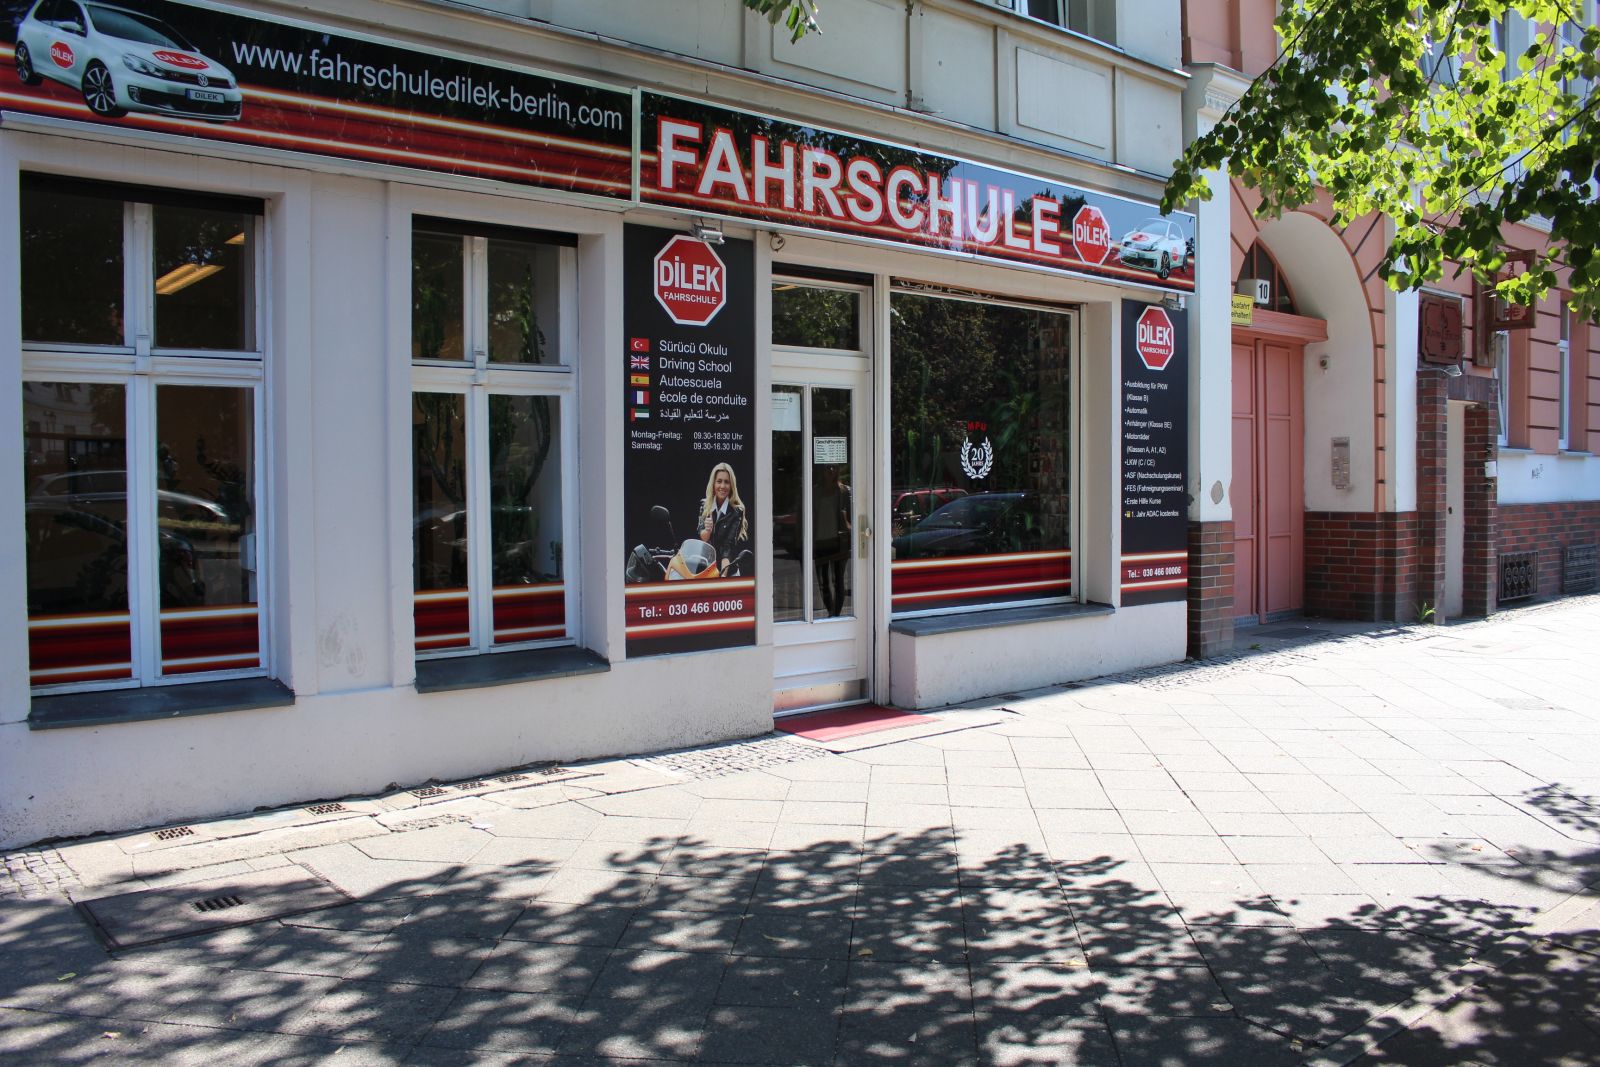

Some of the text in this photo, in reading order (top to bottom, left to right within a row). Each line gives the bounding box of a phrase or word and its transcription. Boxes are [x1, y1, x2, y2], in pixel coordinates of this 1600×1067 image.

[232, 40, 624, 131] www.fahrschuledilek-berlin.com
[660, 118, 1061, 254] FAHRSCHULE
[1076, 221, 1108, 247] DİLEK
[660, 256, 720, 292] DİLEK
[1259, 283, 1268, 299] 10
[664, 292, 716, 304] FAHRSCHULE
[1140, 320, 1170, 346] DİLEK
[660, 340, 728, 355] Sürücü Okulu
[1142, 346, 1168, 354] FAHRSCHULE
[660, 358, 732, 373] Driving School
[660, 375, 722, 388] Autoescuela
[1126, 380, 1150, 390] Ausbildung
[660, 391, 747, 406] école de conduite
[1126, 393, 1142, 402] (Klasse
[968, 421, 987, 432] MPU
[1148, 421, 1163, 429] (Klasse
[1164, 421, 1172, 430] BE)
[631, 430, 682, 440] Montag-Freitag:
[694, 432, 730, 440] 09.30-18:30
[631, 442, 662, 450] Samstag:
[971, 448, 984, 460] 20
[1147, 459, 1155, 467] CE)
[1128, 567, 1181, 578] Tel.: 030 466 00006
[639, 600, 743, 618] Tel.: 030 466 00006
